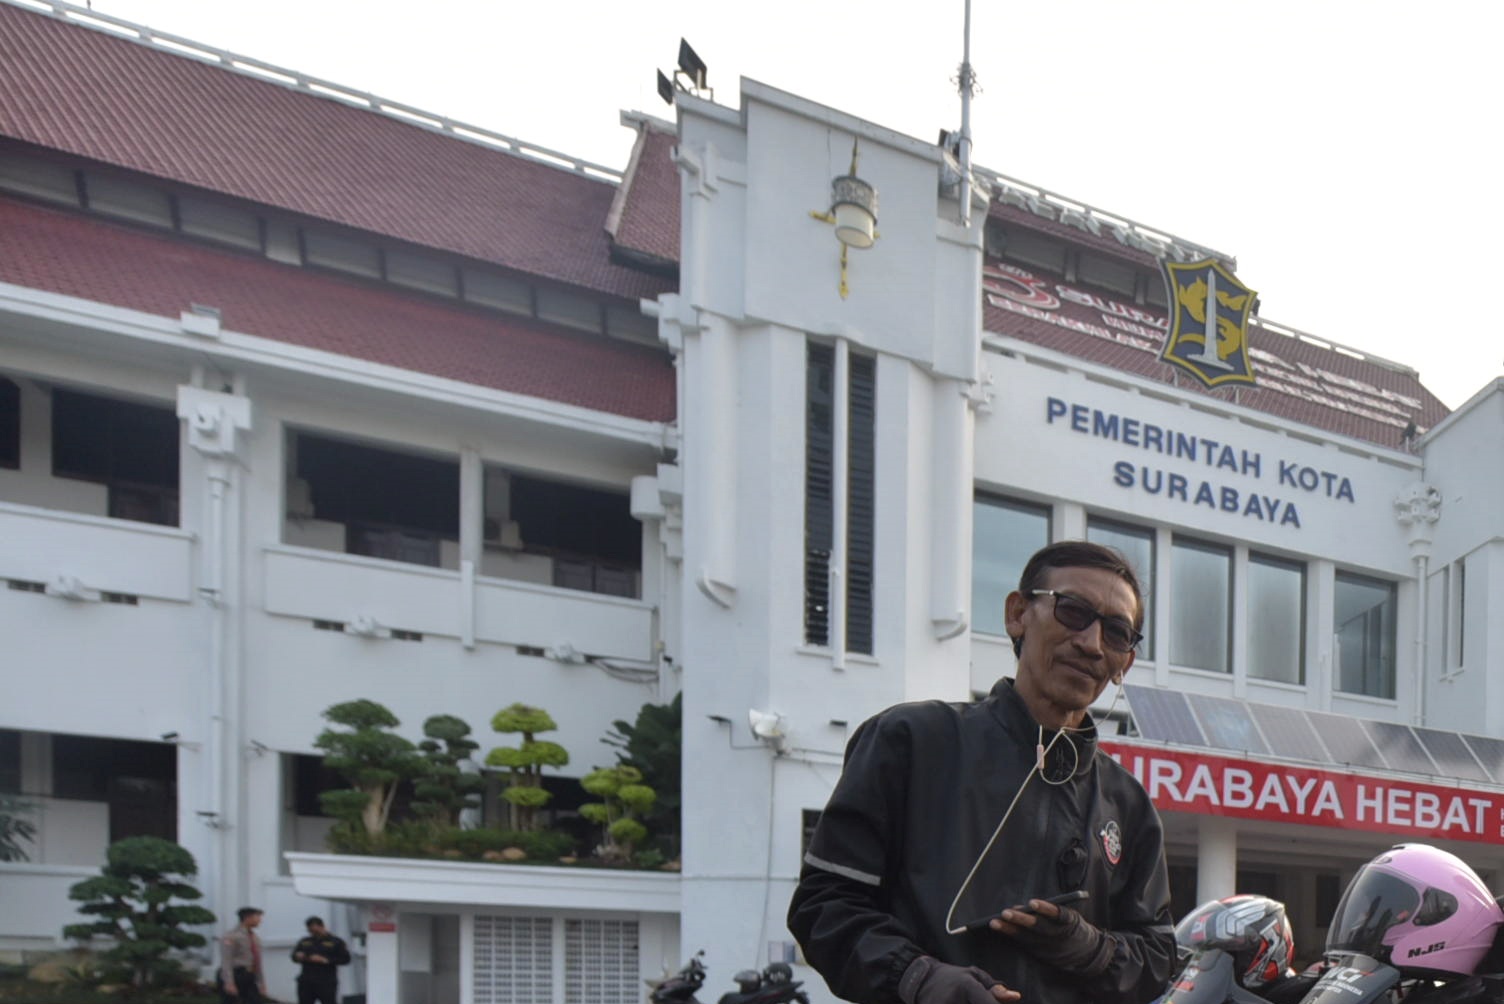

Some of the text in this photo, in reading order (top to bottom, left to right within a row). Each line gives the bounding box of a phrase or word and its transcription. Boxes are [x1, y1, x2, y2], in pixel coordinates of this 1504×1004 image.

[1046, 396, 1262, 479] PEMERINTAH
[1278, 459, 1356, 504] KOTA
[1112, 460, 1302, 529] SURABAYA
[1356, 784, 1492, 835] HEBAT
[1407, 941, 1446, 958] NJS
